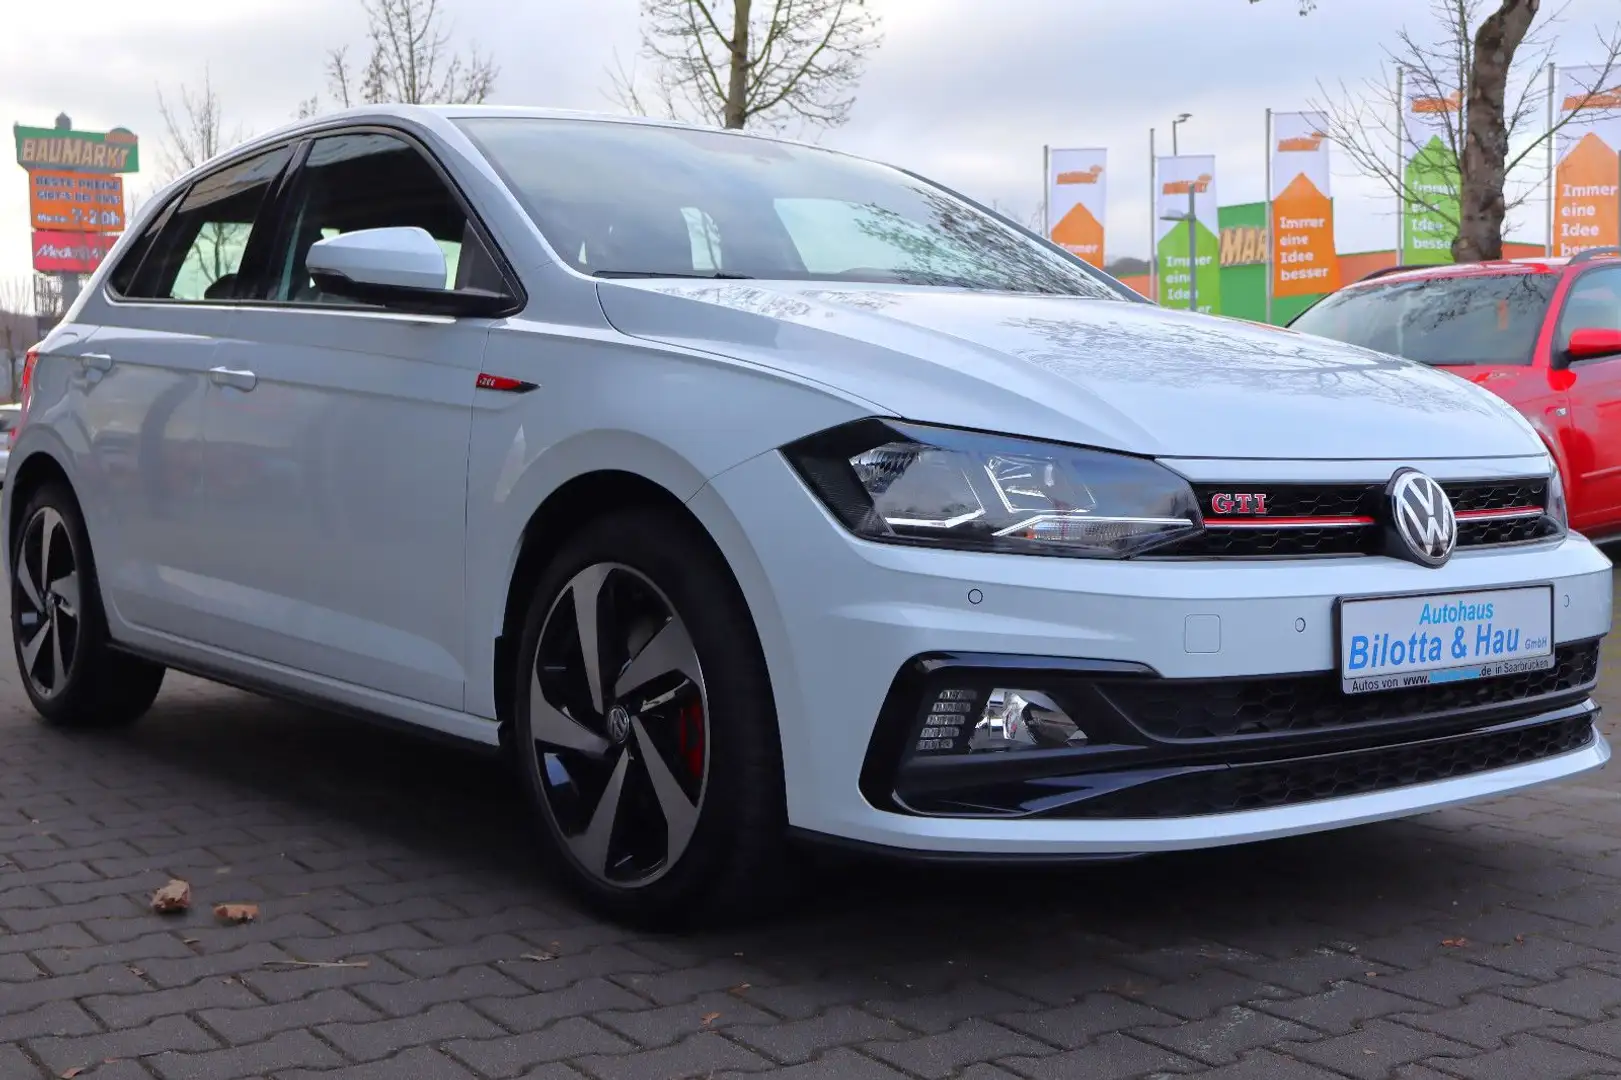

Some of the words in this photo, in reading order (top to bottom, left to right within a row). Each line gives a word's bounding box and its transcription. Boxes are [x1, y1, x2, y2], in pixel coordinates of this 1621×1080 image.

[22, 137, 129, 168] BAUMARKT
[1562, 183, 1619, 198] Immer
[1561, 203, 1595, 217] eine
[1280, 216, 1325, 229] Immer
[1561, 223, 1599, 237] Idee
[1280, 233, 1309, 246] eine
[1412, 236, 1452, 249] besse
[1280, 250, 1314, 264] Idee
[1165, 270, 1191, 284] ein
[1281, 267, 1329, 281] besser
[1167, 288, 1199, 300] Ide
[1212, 493, 1267, 513] GTI
[1419, 601, 1494, 625] Autohaus
[1349, 631, 1442, 670] Bilotta
[1451, 625, 1467, 659] &
[1475, 623, 1519, 657] Hau
[1525, 637, 1547, 650] GmbH
[1352, 680, 1379, 692] Autos
[1382, 678, 1399, 688] von
[1495, 663, 1502, 674] in
[1504, 659, 1549, 673] Saarbrücken
